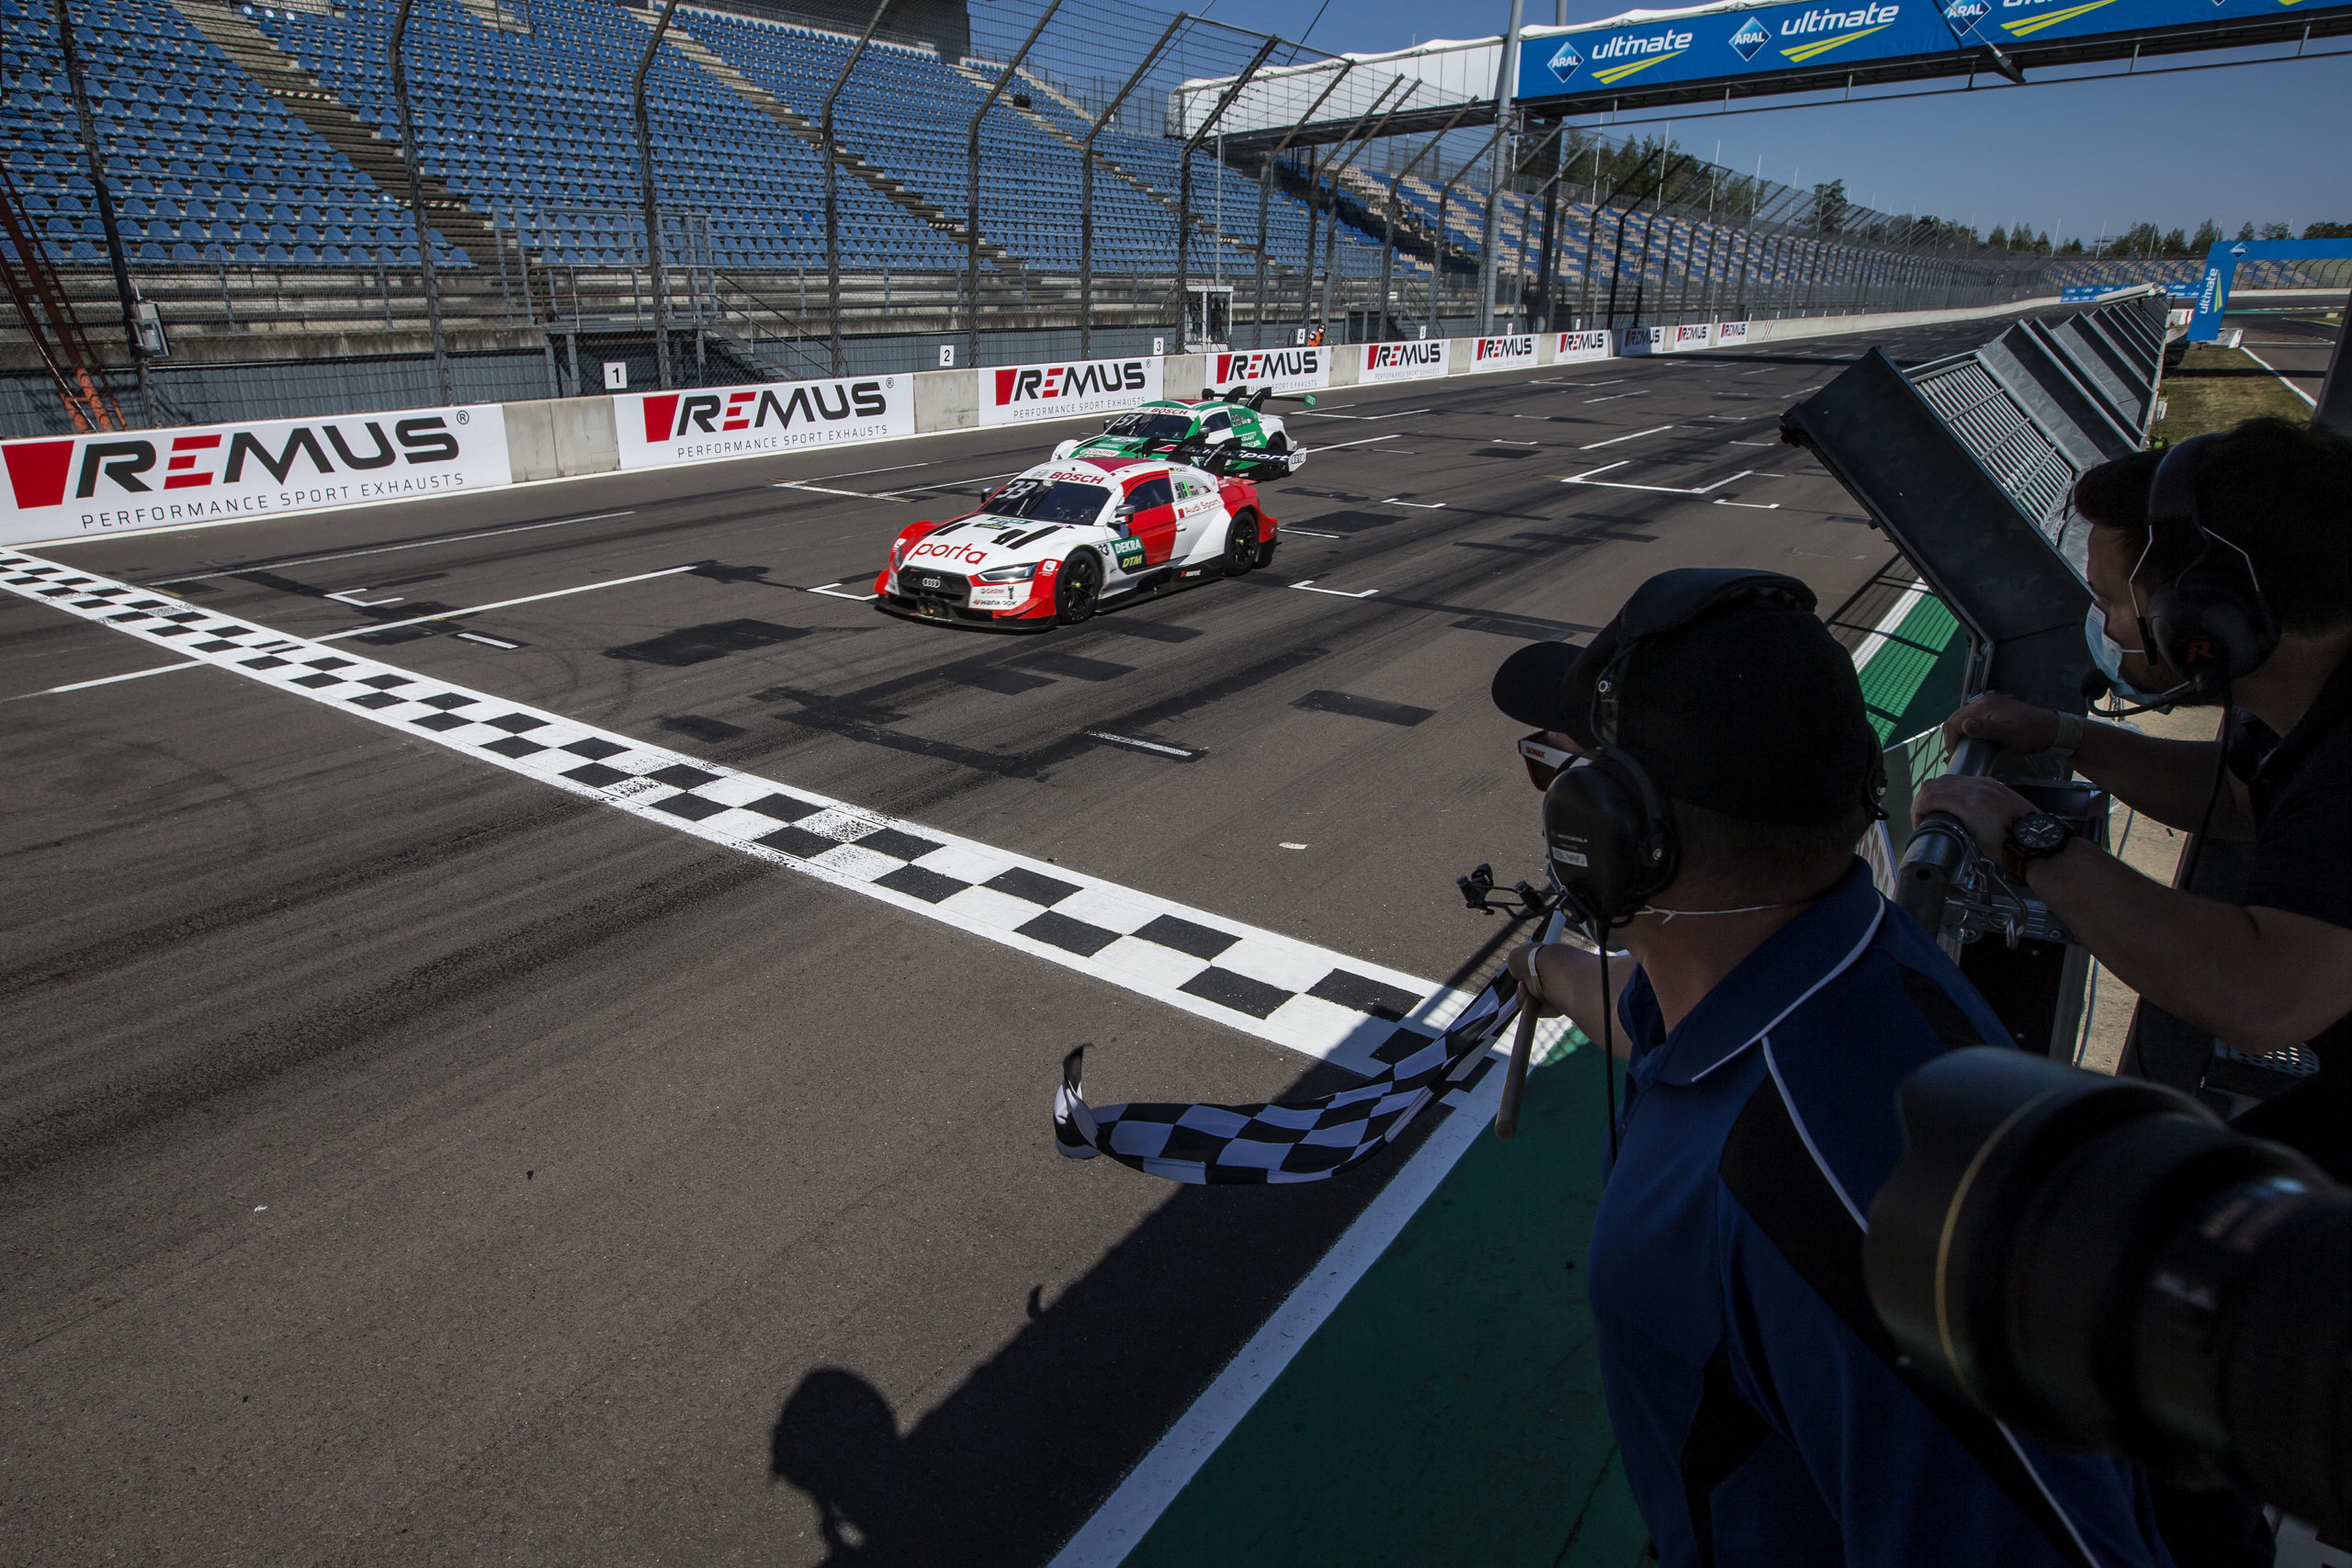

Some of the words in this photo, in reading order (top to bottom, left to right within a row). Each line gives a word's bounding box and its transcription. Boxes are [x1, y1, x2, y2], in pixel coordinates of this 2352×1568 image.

[1781, 2, 1899, 36] ultimate
[1947, 4, 1984, 18] ARAL
[1591, 29, 1692, 60] ultimate
[1734, 31, 1765, 45] ARAL
[1552, 55, 1578, 68] ARAL
[2199, 267, 2219, 314] ultimate
[1299, 331, 1304, 340] 4
[1565, 333, 1604, 350] REMUS
[1628, 329, 1660, 346] REMUS
[1680, 326, 1707, 341] REMUS
[1156, 341, 1161, 352] 3
[1484, 337, 1532, 358] REMUS
[944, 349, 951, 362] 2
[1376, 344, 1441, 367] REMUS
[1228, 351, 1317, 380] REMUS
[613, 367, 620, 383] 1
[1014, 362, 1146, 401] REMUS
[1272, 382, 1288, 390] SPORT
[1290, 379, 1317, 388] EXHAUSTS
[676, 381, 887, 436] REMUS
[1014, 404, 1075, 419] PERFORMANCE
[1080, 400, 1104, 412] SPORT
[1107, 397, 1146, 409] EXHAUSTS
[1150, 407, 1189, 415] BOSCH
[1114, 413, 1144, 426] 51
[678, 437, 778, 458] PERFORMANCE
[784, 432, 822, 446] SPORT
[829, 424, 888, 441] EXHAUSTS
[75, 416, 459, 499] REMUS
[1048, 471, 1105, 484] BOSCH
[993, 479, 1038, 500] 33
[81, 494, 268, 529] PERFORMANCE
[280, 485, 348, 507] SPORT
[361, 472, 463, 496] EXHAUSTS
[1185, 503, 1201, 513] Audi
[908, 543, 989, 565] porta
[1114, 538, 1142, 554] DEKRA
[1122, 554, 1143, 568] DTM
